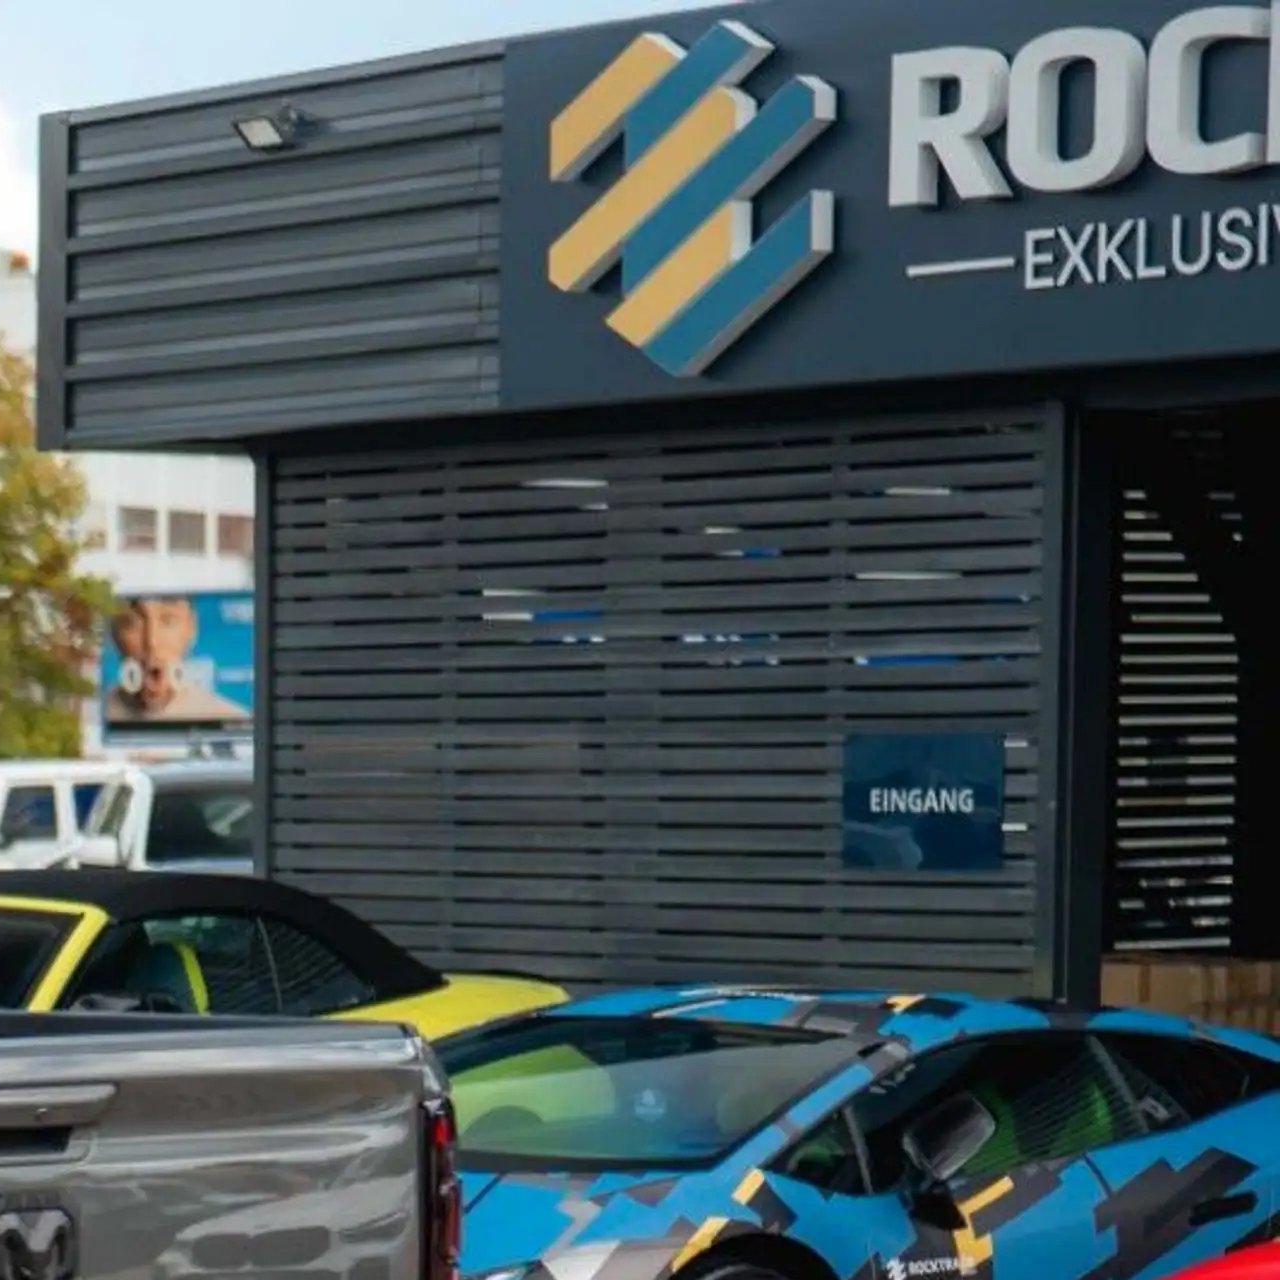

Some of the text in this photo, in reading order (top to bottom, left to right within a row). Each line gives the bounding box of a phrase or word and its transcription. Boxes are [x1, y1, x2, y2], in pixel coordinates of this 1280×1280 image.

[888, 0, 1280, 208] ROC
[1024, 203, 1280, 290] EXKLUSI
[869, 786, 975, 816] EINGANG
